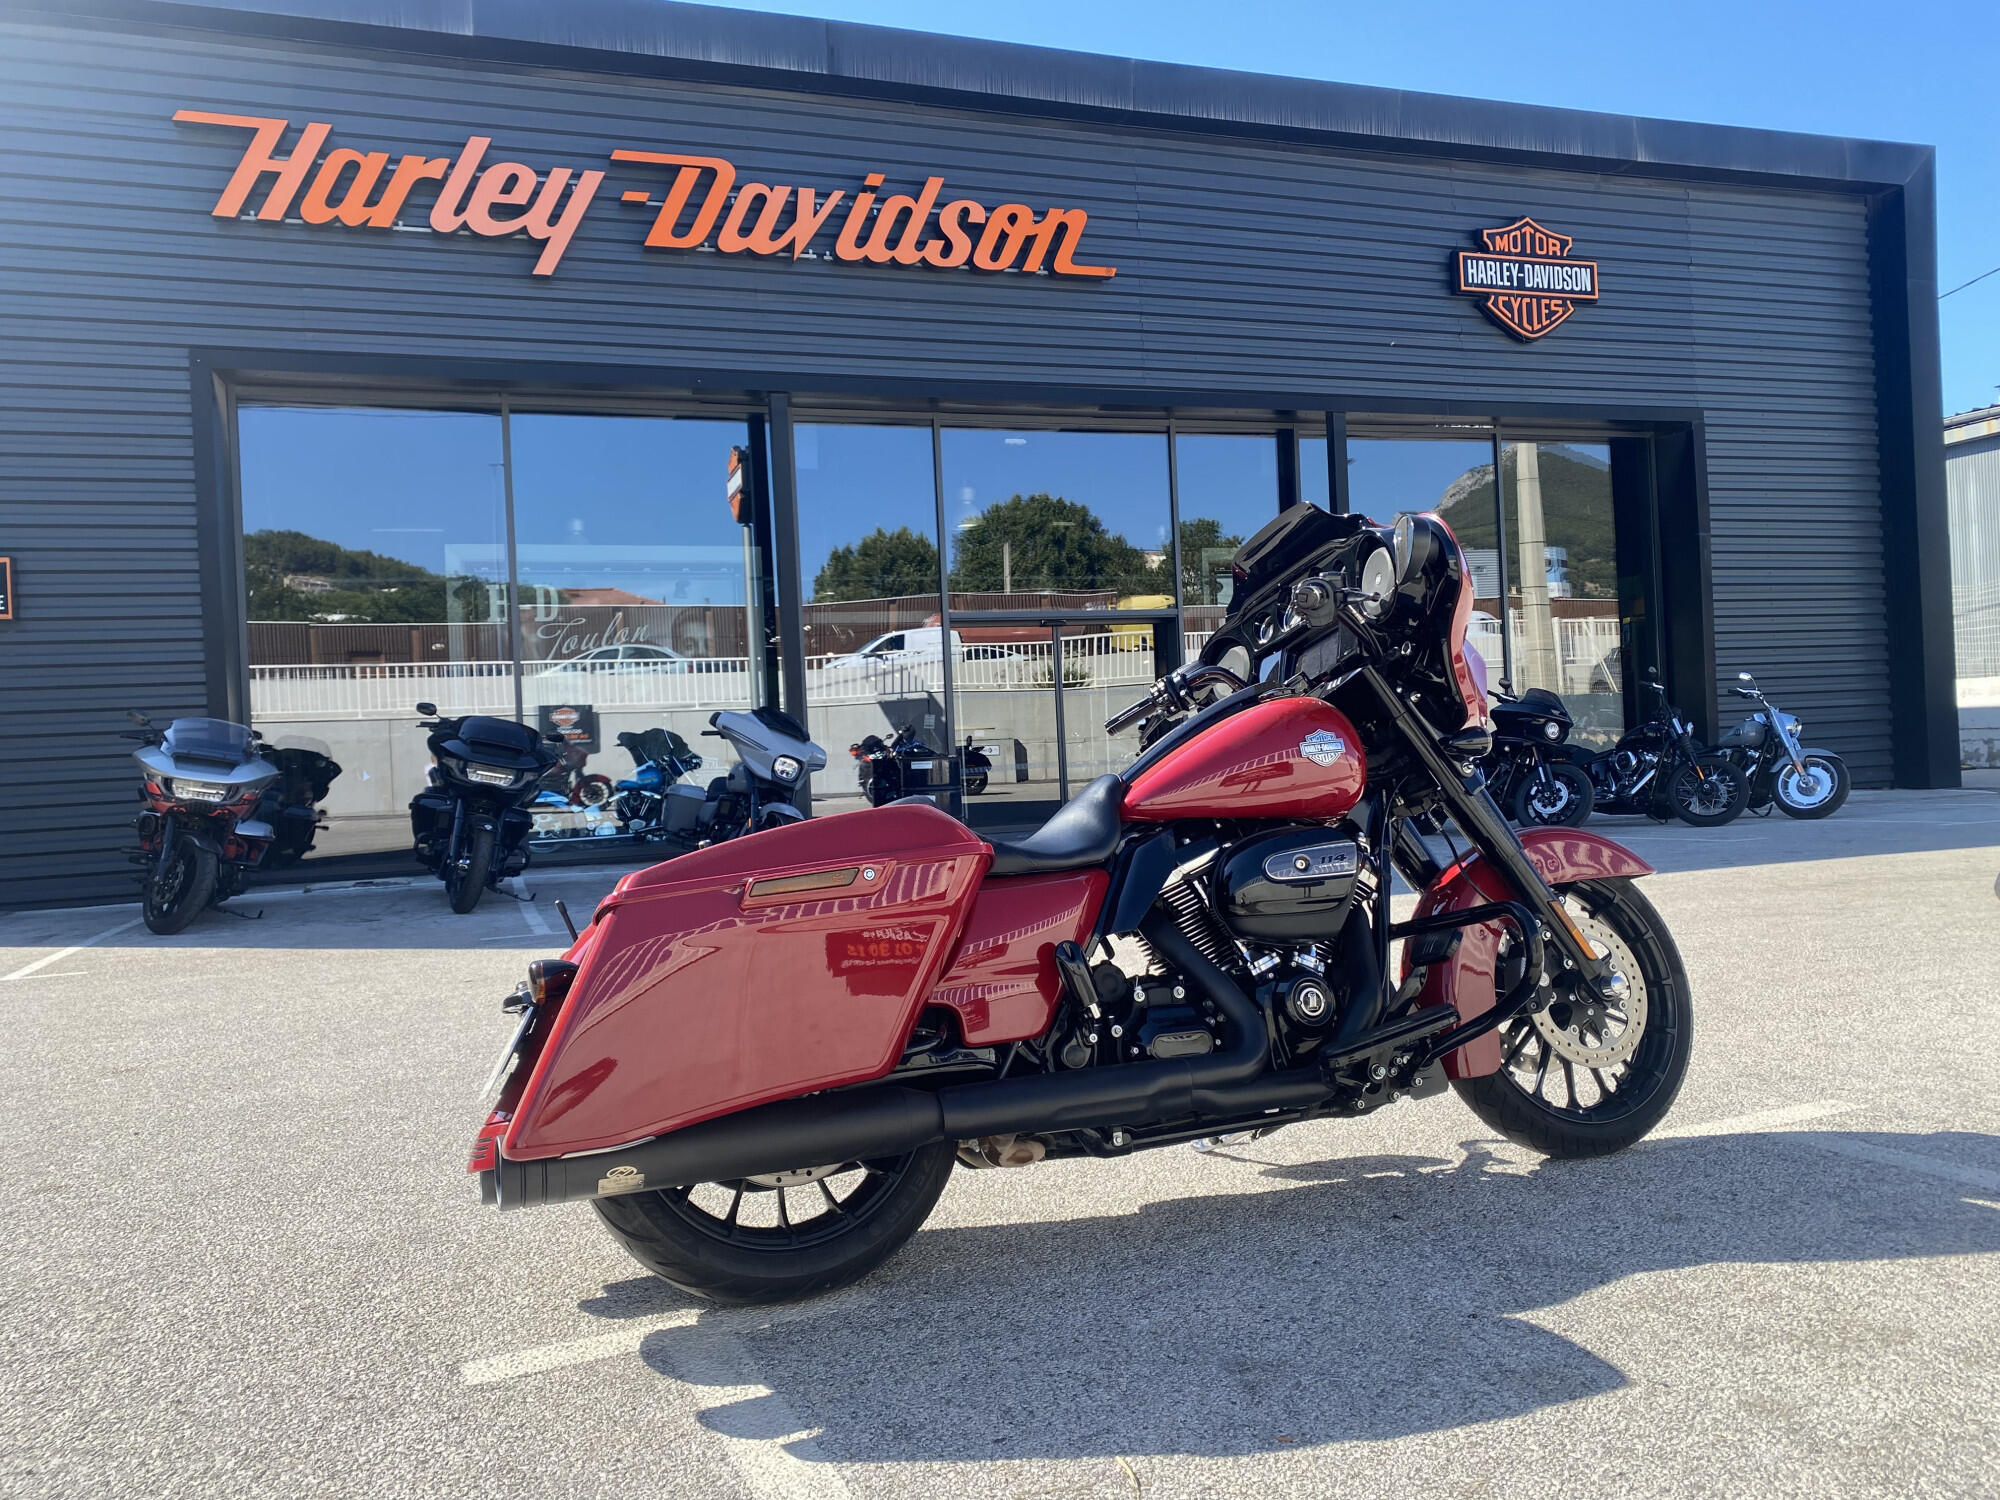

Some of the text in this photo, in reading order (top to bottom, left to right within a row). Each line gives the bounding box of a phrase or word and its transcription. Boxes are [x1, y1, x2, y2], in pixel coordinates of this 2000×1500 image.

[1494, 225, 1561, 257] MOTOR
[1467, 258, 1592, 293] HARLEY-DAVIDSON
[1497, 295, 1564, 332] CYCLES
[537, 612, 649, 661] Toulon
[1319, 853, 1347, 864] 114
[1307, 991, 1319, 1011] 1
